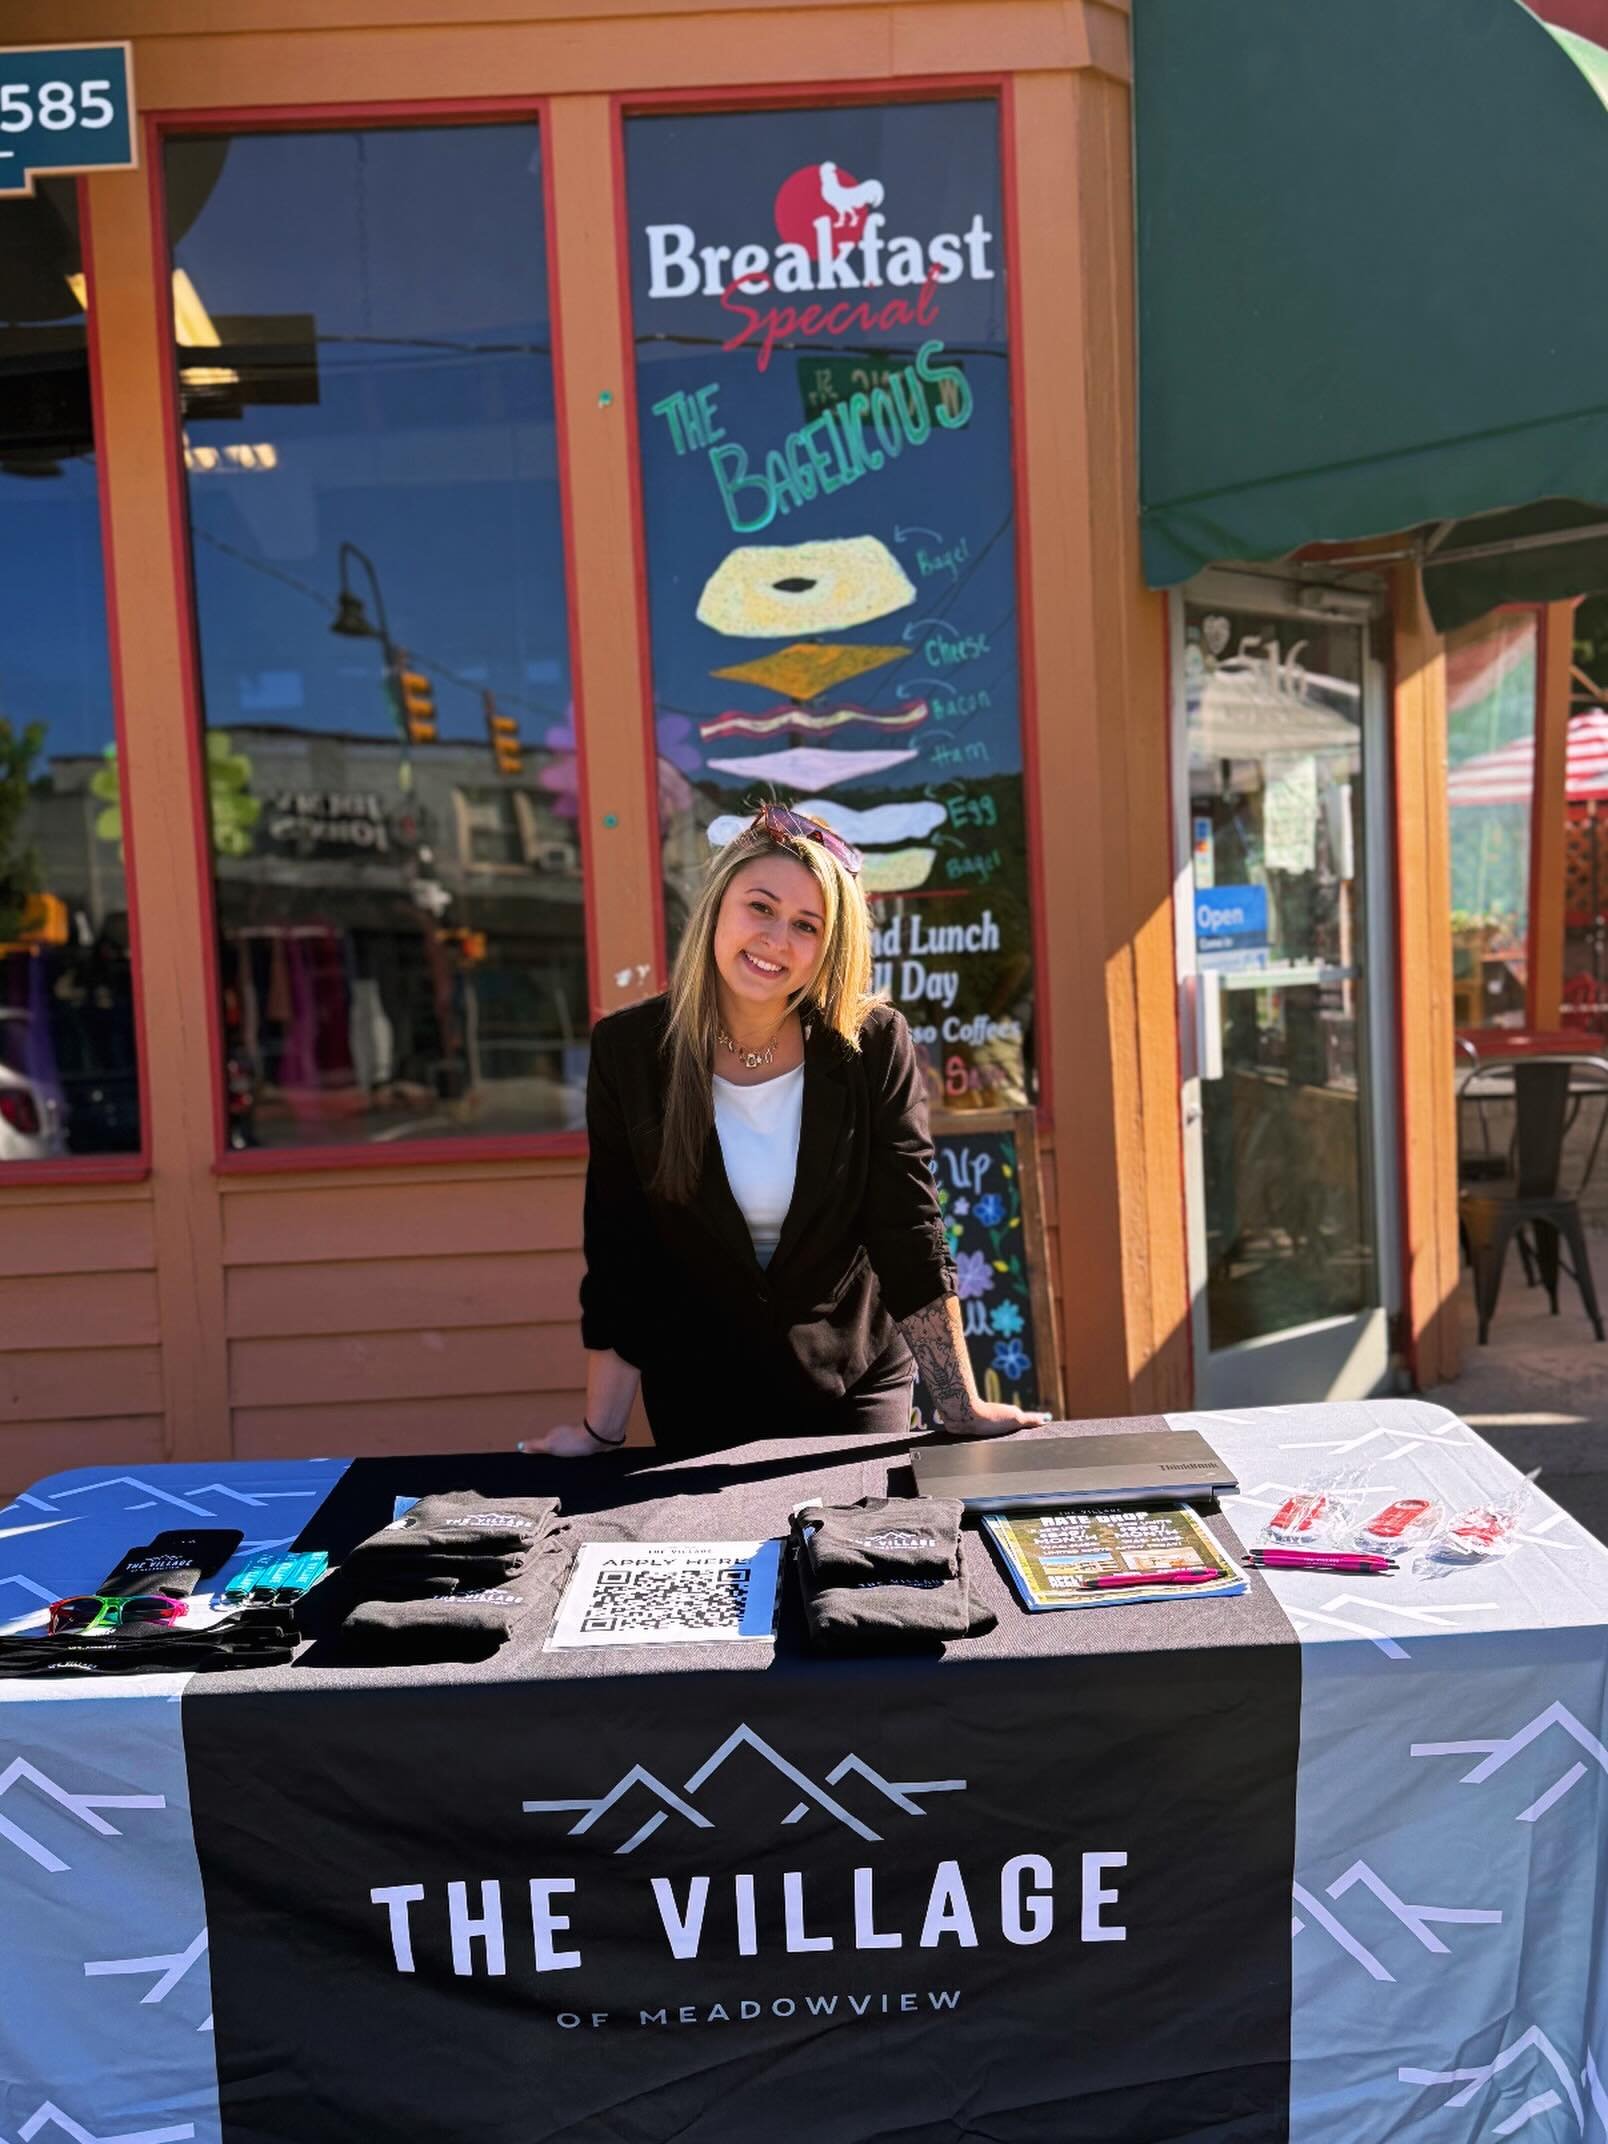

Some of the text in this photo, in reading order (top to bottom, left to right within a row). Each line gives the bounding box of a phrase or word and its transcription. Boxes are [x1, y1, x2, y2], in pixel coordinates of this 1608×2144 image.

[1, 80, 114, 133] 585
[645, 211, 995, 299] Breakfast
[720, 262, 945, 373] Special
[652, 382, 726, 455] THE
[925, 633, 991, 667] Cheese
[945, 794, 998, 830] Egg
[871, 910, 1000, 957] nd Lunch
[1197, 904, 1245, 933] Open
[901, 960, 959, 1008] Day
[942, 1014, 1021, 1046] Coffees
[942, 1147, 992, 1194] Up
[686, 1557, 752, 1565] HERE
[371, 1851, 1127, 1976] THE VILLAGE
[556, 1990, 962, 2029] OF MEADOWVIEW
